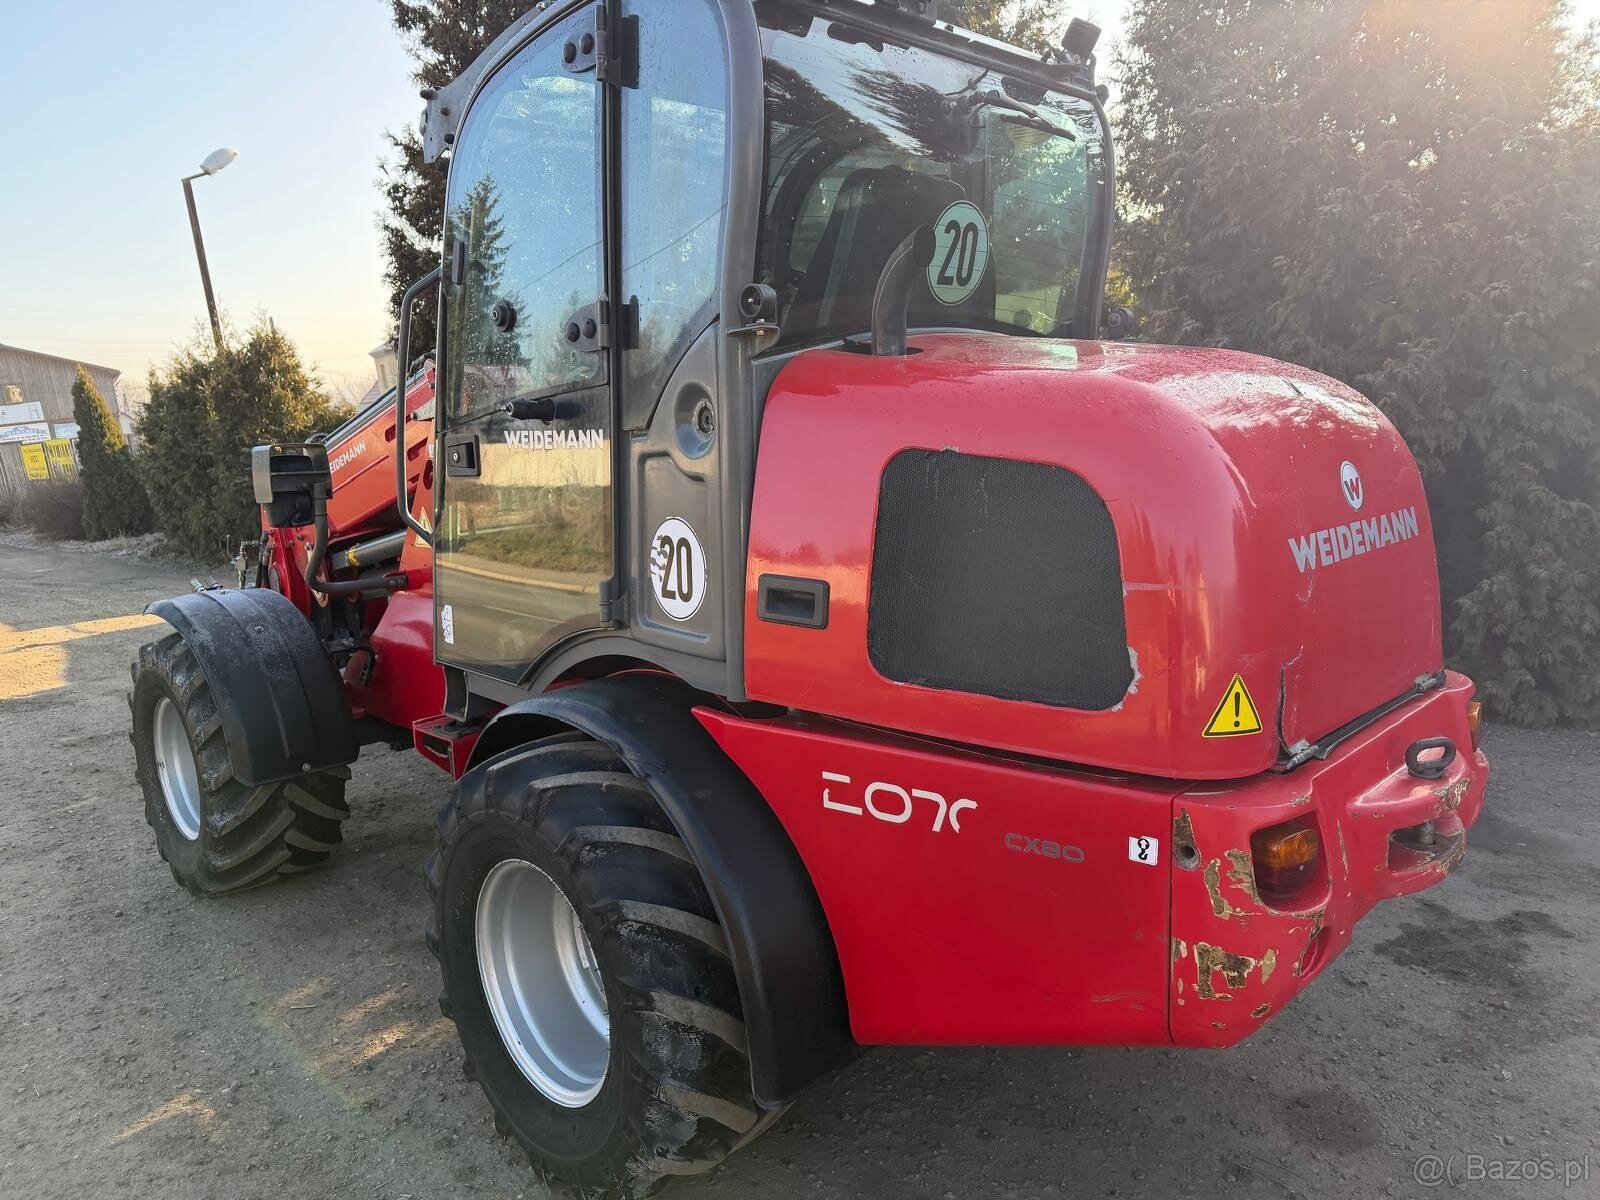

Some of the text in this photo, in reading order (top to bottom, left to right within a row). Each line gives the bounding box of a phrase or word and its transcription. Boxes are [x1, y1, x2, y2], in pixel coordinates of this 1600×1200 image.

[936, 219, 979, 287] 20
[329, 440, 367, 474] EIDEMANN
[503, 429, 604, 450] WEIDEMANN
[660, 535, 693, 603] 20
[1287, 506, 1419, 573] WEIDEMANN
